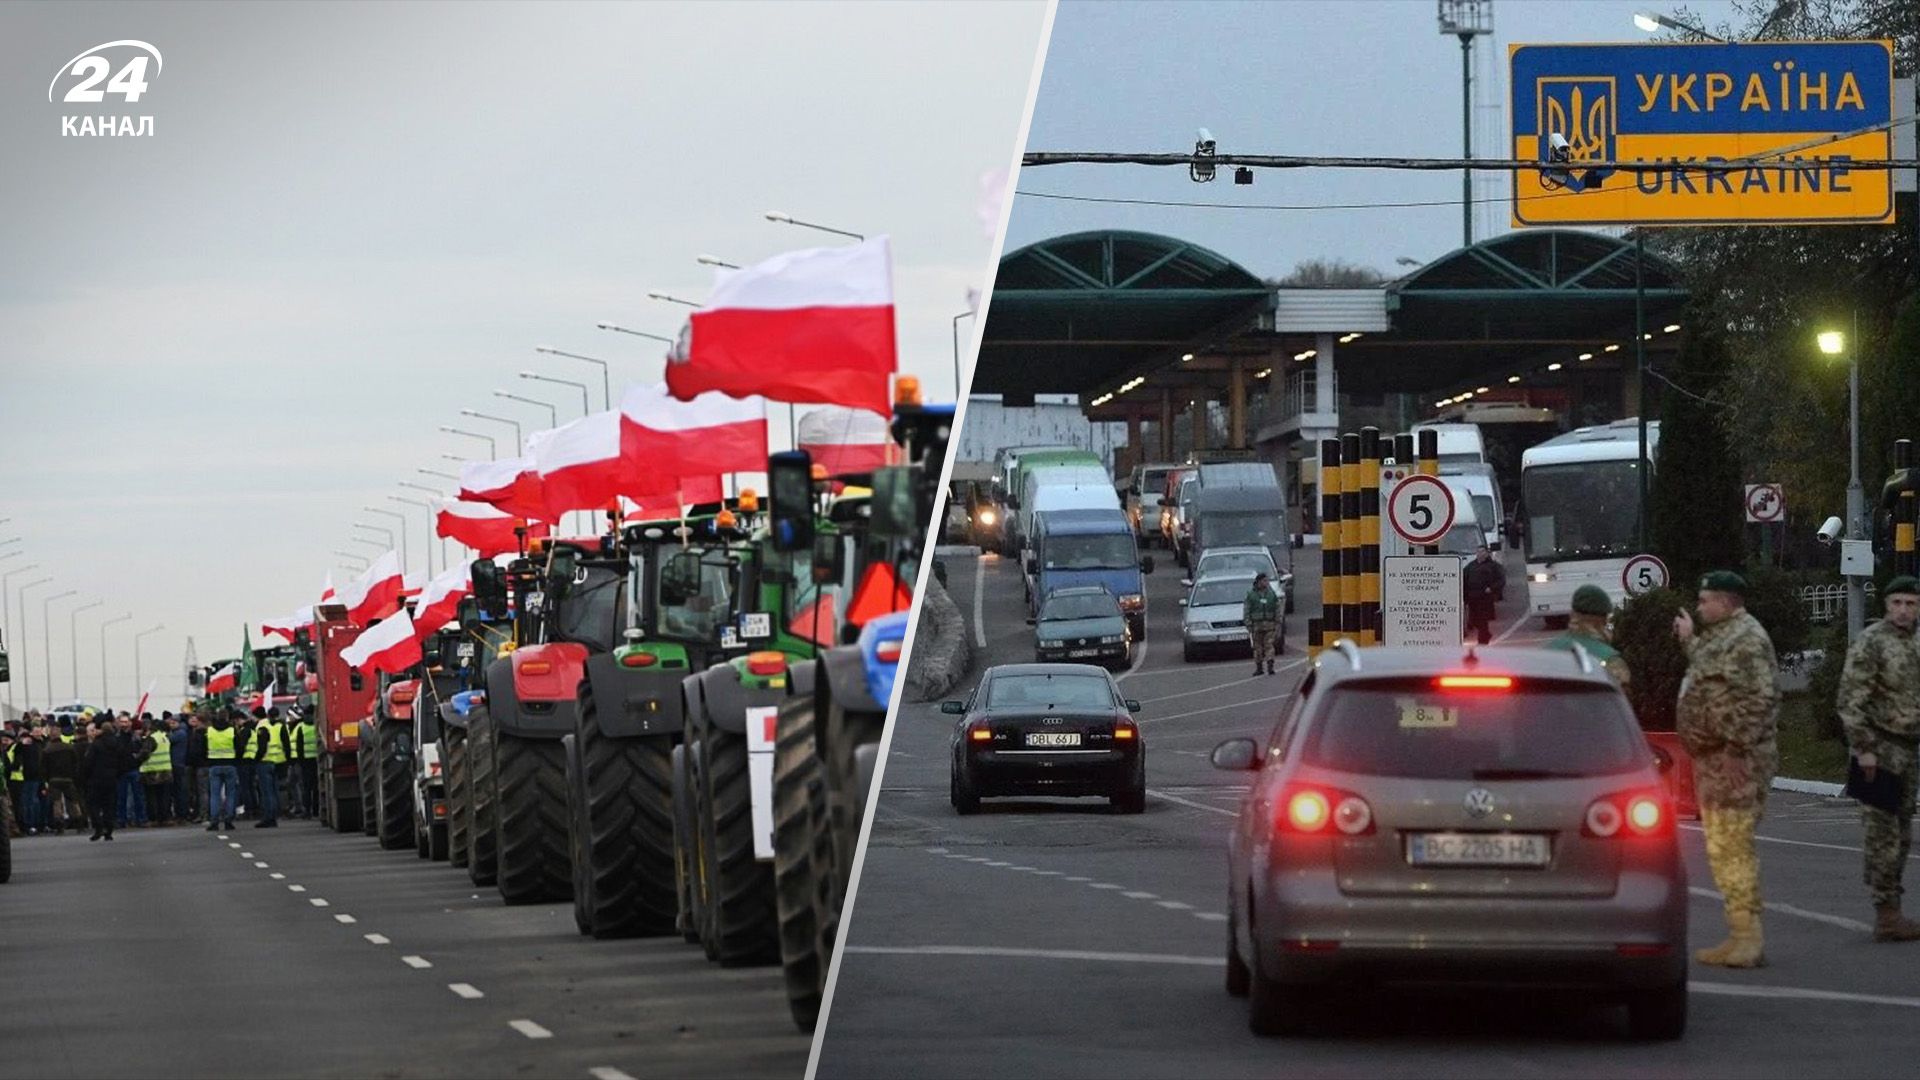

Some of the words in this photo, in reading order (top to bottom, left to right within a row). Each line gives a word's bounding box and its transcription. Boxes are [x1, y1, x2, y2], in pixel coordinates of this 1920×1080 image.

[1635, 61, 1865, 113] УКРАЇНА
[1636, 155, 1853, 195] UKRAINE
[1409, 494, 1433, 531] 5
[1638, 567, 1652, 588] 5
